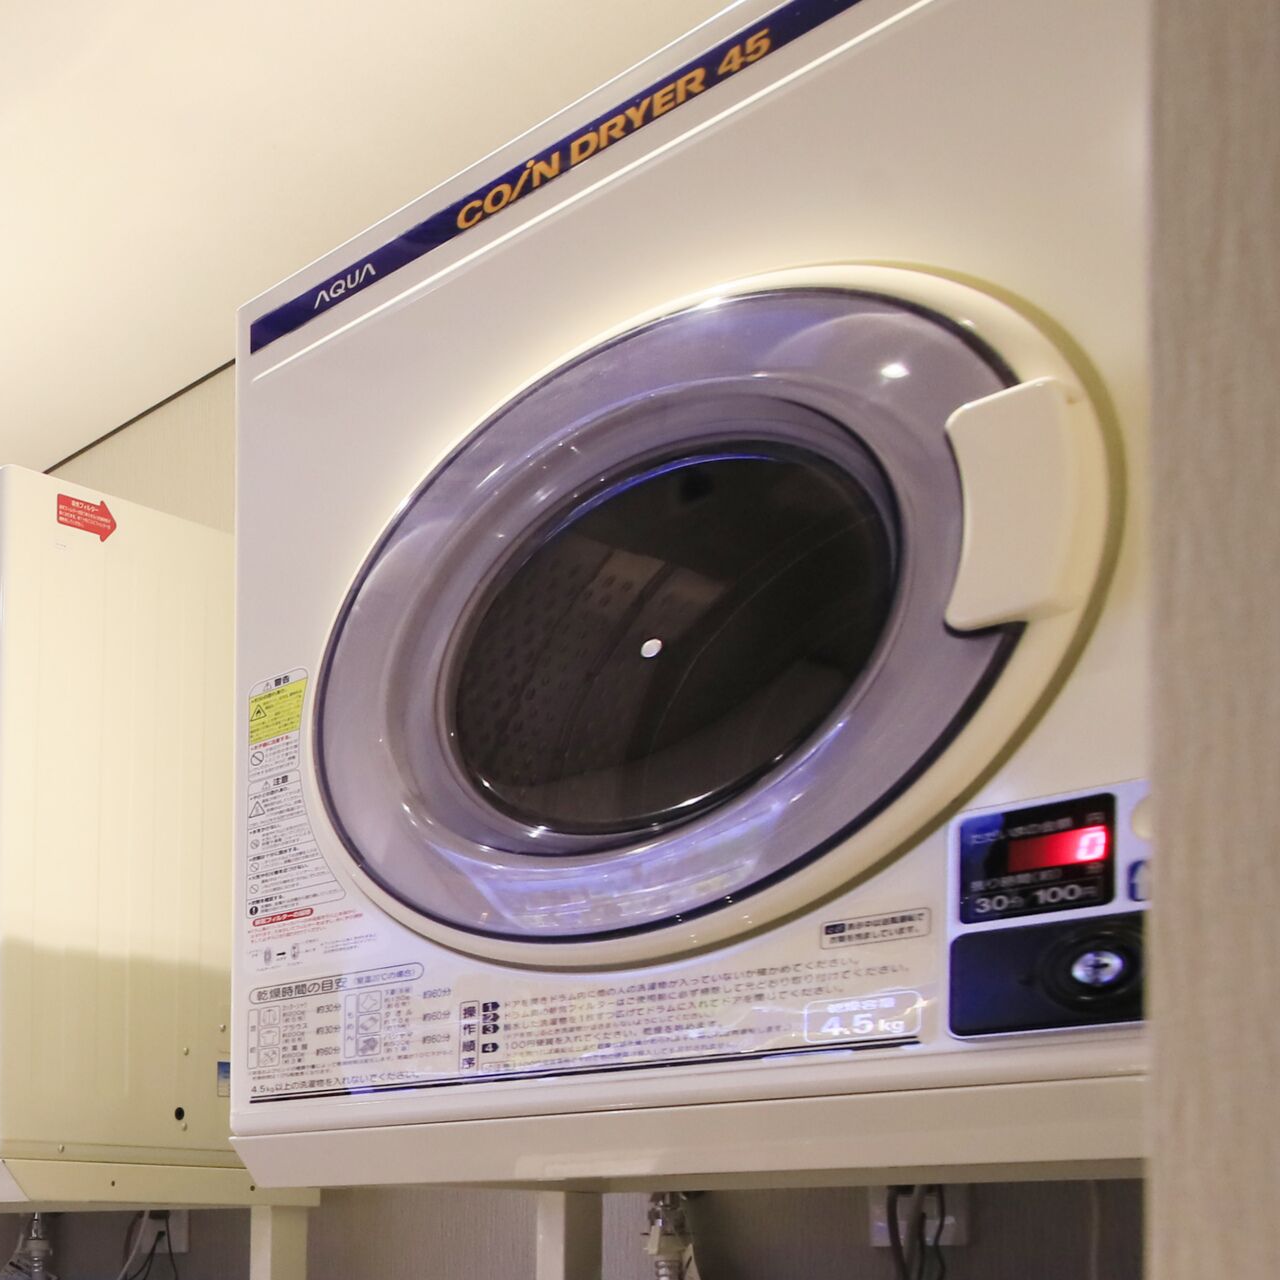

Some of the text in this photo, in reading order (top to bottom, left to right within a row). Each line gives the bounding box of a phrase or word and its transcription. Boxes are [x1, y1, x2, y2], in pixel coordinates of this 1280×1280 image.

[457, 28, 771, 231] COIN DRYER 45
[314, 263, 376, 310] AQUA
[1076, 831, 1107, 861] 0
